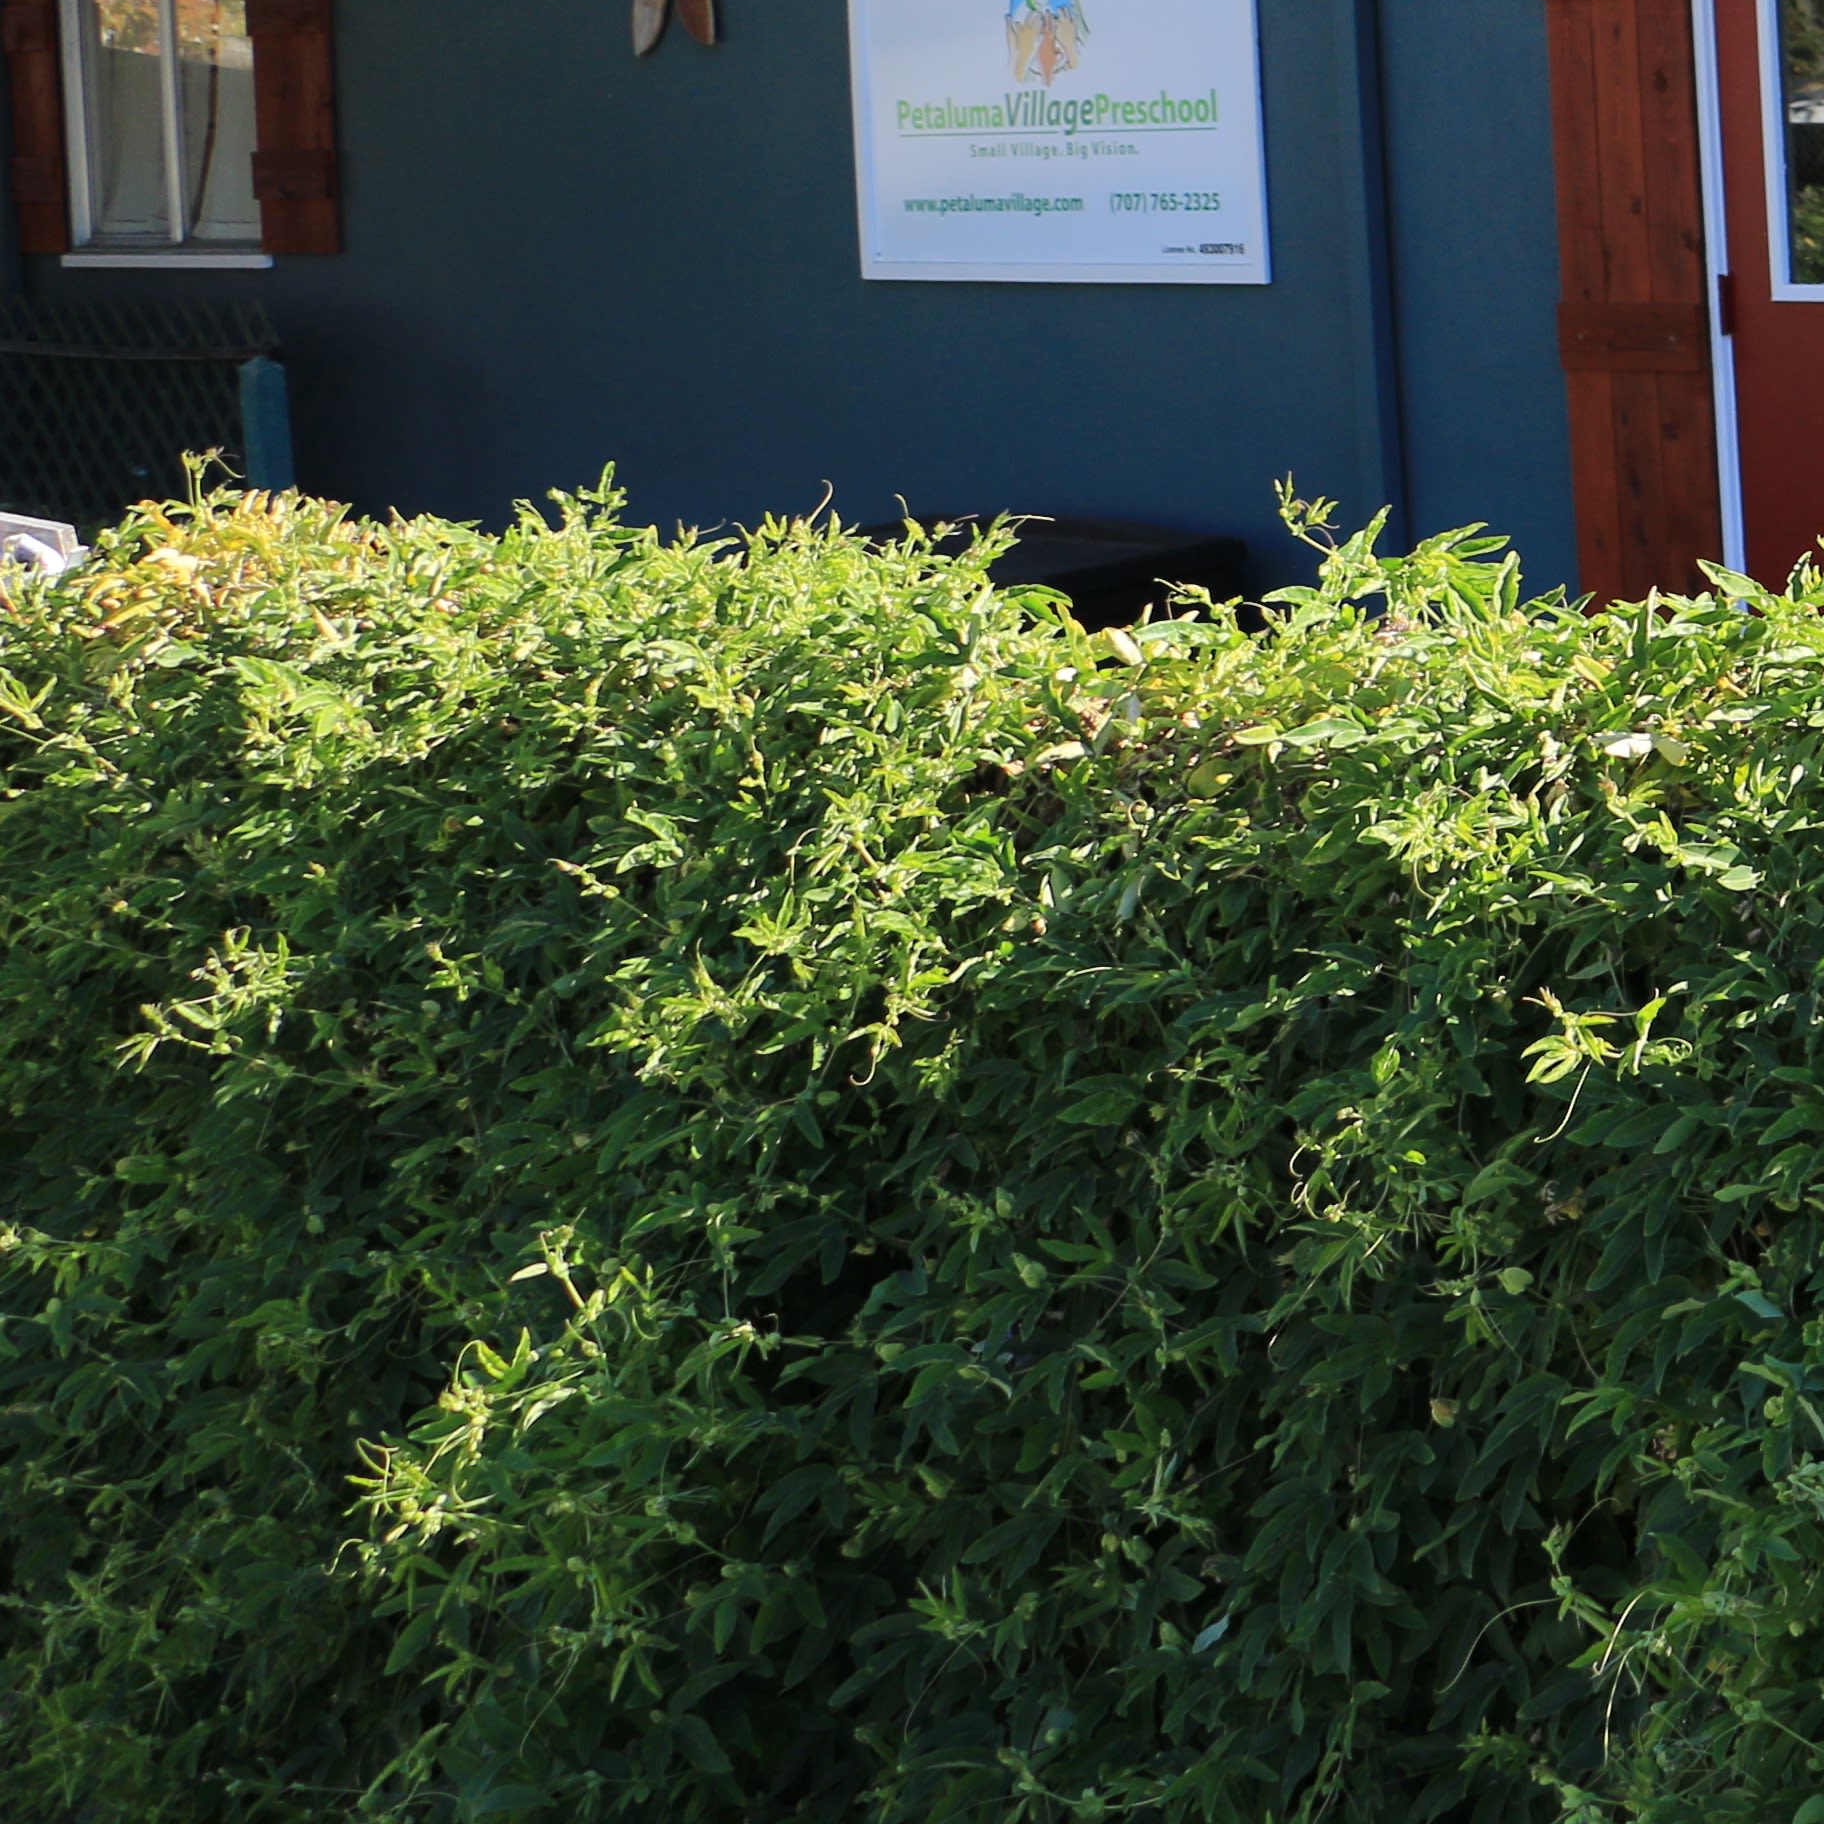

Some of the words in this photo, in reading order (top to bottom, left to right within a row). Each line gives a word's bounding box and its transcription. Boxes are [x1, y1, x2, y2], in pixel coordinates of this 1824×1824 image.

[969, 143, 1006, 158] Small
[1011, 141, 1063, 159] Village.
[1066, 140, 1088, 159] Big
[1091, 139, 1140, 156] Vision.
[904, 193, 1084, 216] www.petalumavillage.com
[1110, 192, 1147, 214] (707)
[1149, 192, 1220, 212] 765-2325
